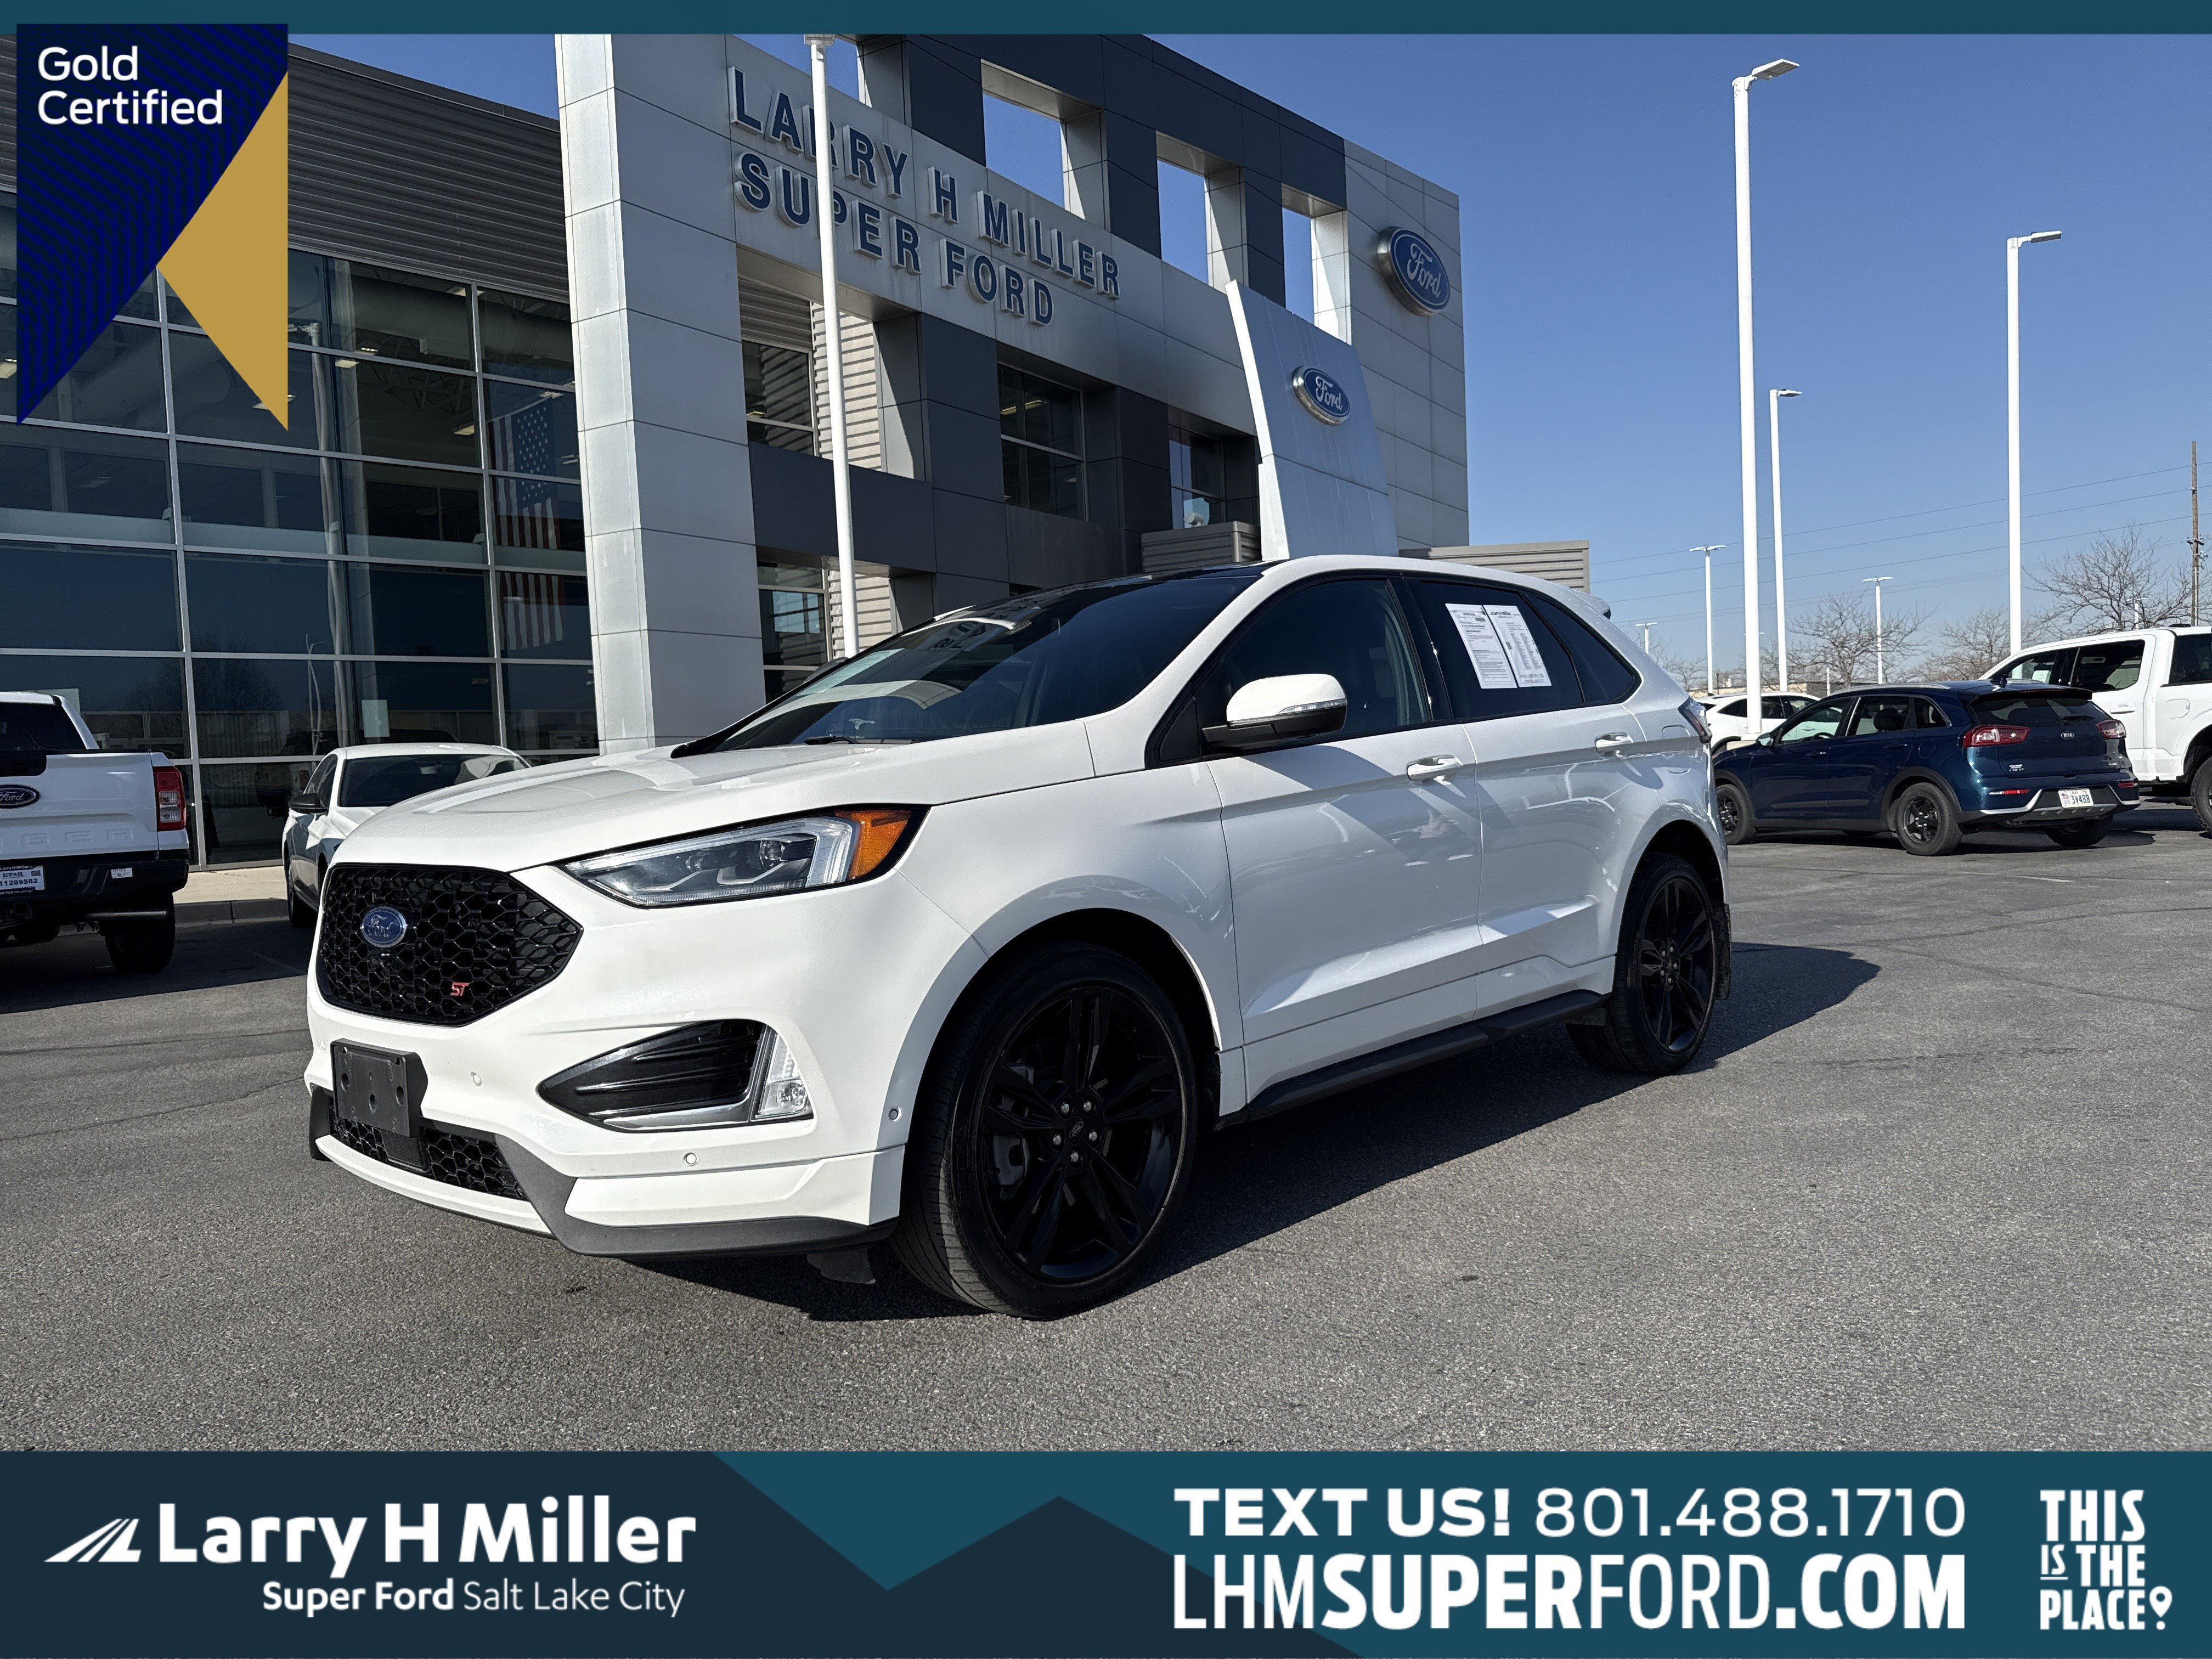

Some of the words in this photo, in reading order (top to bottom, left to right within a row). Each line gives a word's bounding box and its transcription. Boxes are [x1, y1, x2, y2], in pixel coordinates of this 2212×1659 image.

[729, 66, 909, 199] LARRY
[928, 166, 959, 224] H
[977, 190, 1121, 300] MILLER
[940, 238, 1054, 326] FORD
[1406, 242, 1442, 298] Ford
[1315, 375, 1343, 411] Ford
[0, 791, 24, 802] Ford
[0, 828, 134, 848] GER
[368, 914, 393, 938] Ford
[450, 981, 470, 996] ST
